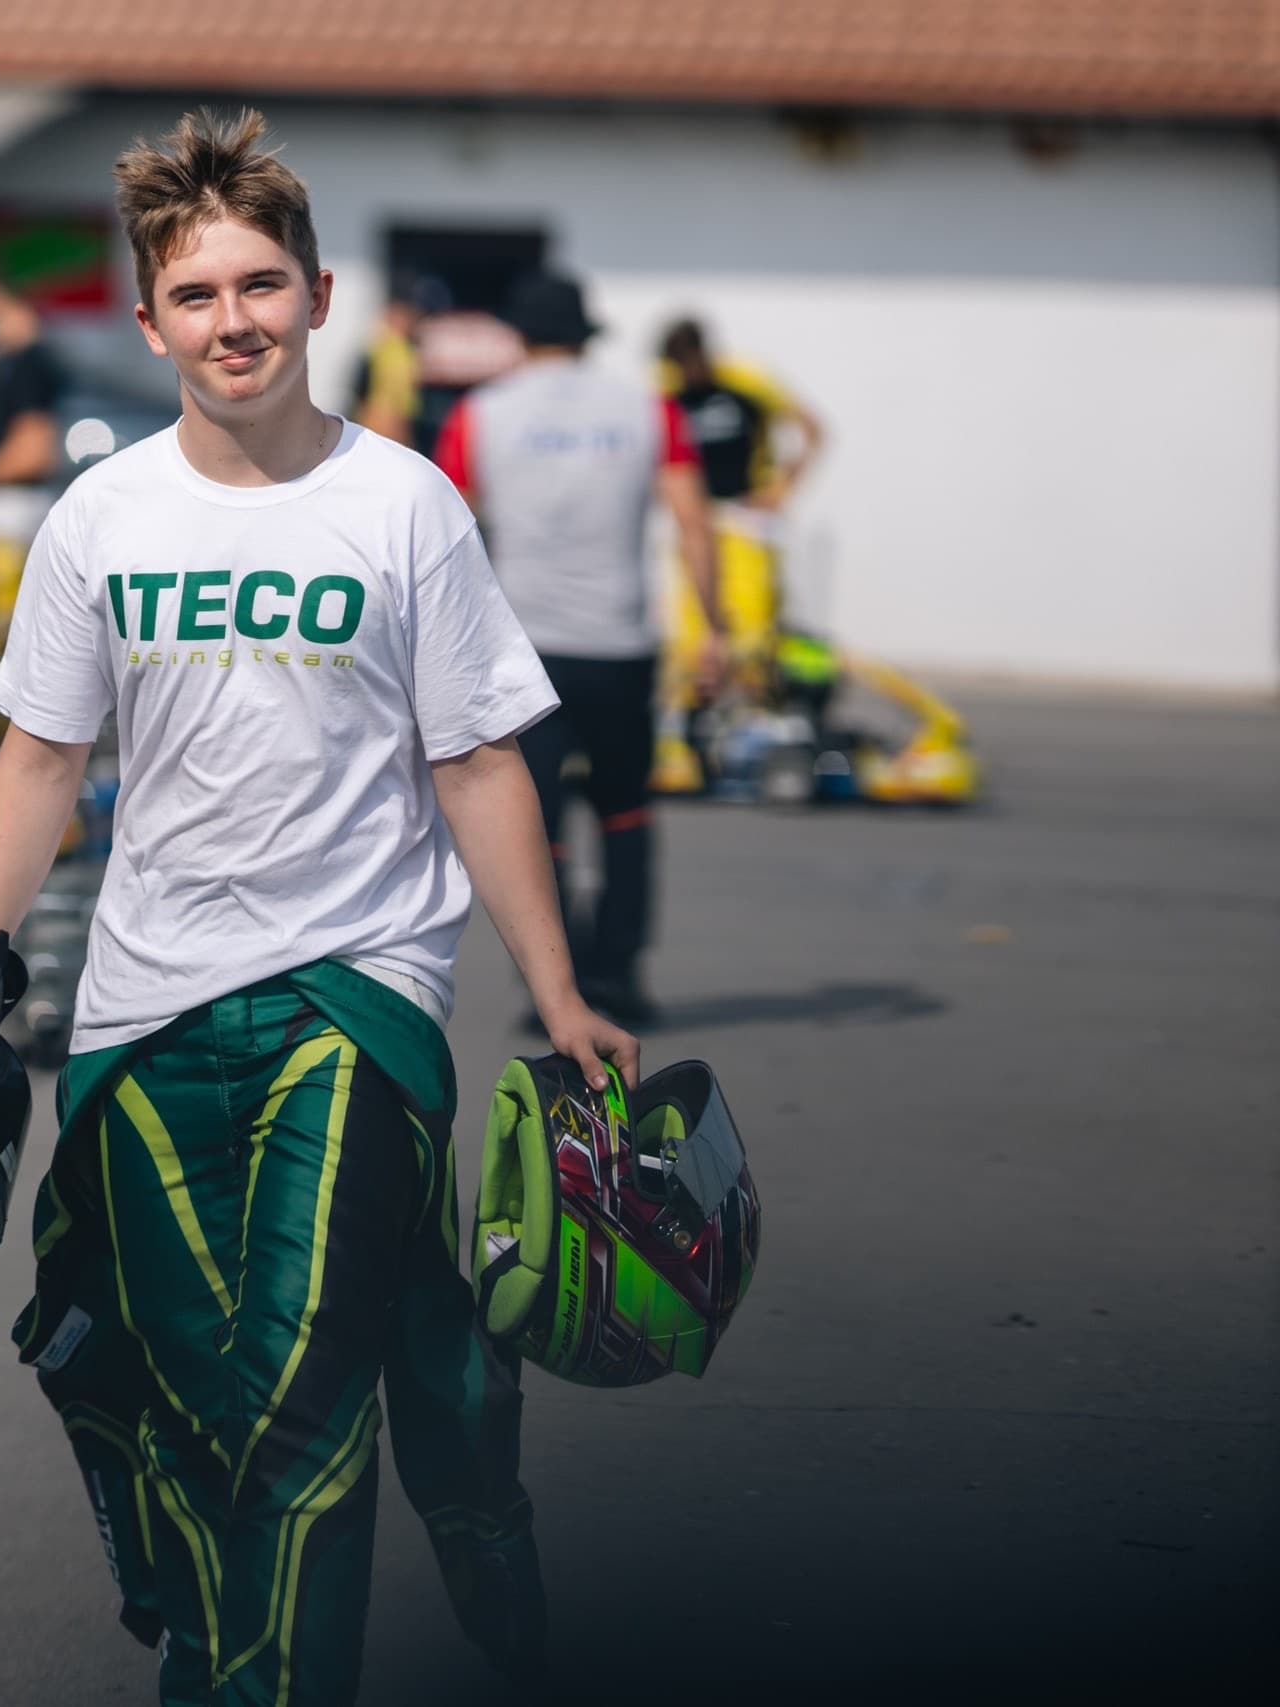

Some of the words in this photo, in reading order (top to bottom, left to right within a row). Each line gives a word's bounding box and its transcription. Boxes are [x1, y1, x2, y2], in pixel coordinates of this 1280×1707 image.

[107, 570, 365, 644] ITECO
[128, 649, 233, 667] acing
[252, 648, 354, 668] team
